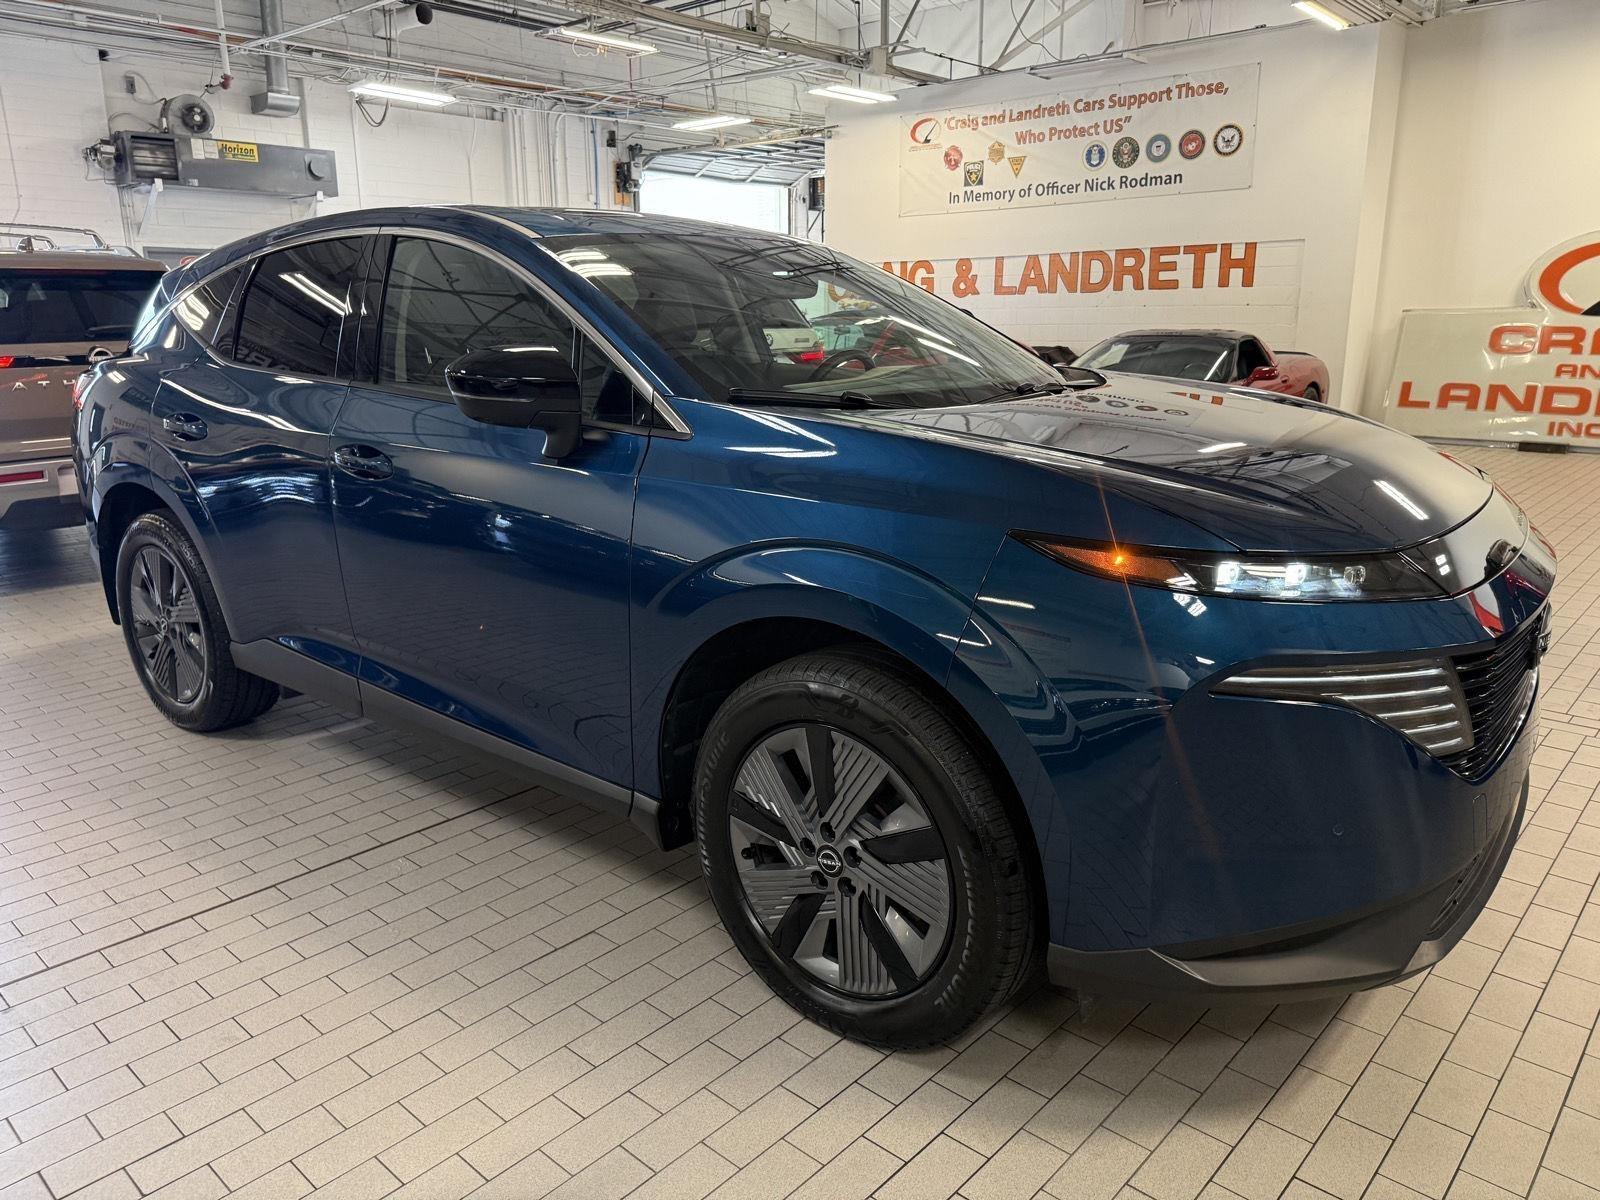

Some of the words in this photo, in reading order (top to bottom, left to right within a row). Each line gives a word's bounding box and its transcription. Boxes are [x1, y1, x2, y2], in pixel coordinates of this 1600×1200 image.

[981, 109, 1006, 126] and
[1008, 101, 1070, 122] Landreth
[1073, 97, 1105, 113] Cars
[1108, 86, 1172, 110] Support
[1175, 81, 1229, 99] Those,
[221, 143, 255, 155] Horizon
[1014, 129, 1046, 146] Who
[1048, 122, 1100, 141] Protect
[949, 191, 960, 204] In
[963, 189, 1015, 203] Memory
[1018, 183, 1032, 198] of
[1034, 181, 1081, 197] Officer
[1084, 176, 1115, 192] Nick
[1119, 172, 1183, 190] Rodman
[953, 257, 980, 298] &
[993, 241, 1257, 296] LANDRETH
[1488, 324, 1600, 356] CR
[1397, 380, 1600, 417] LAND
